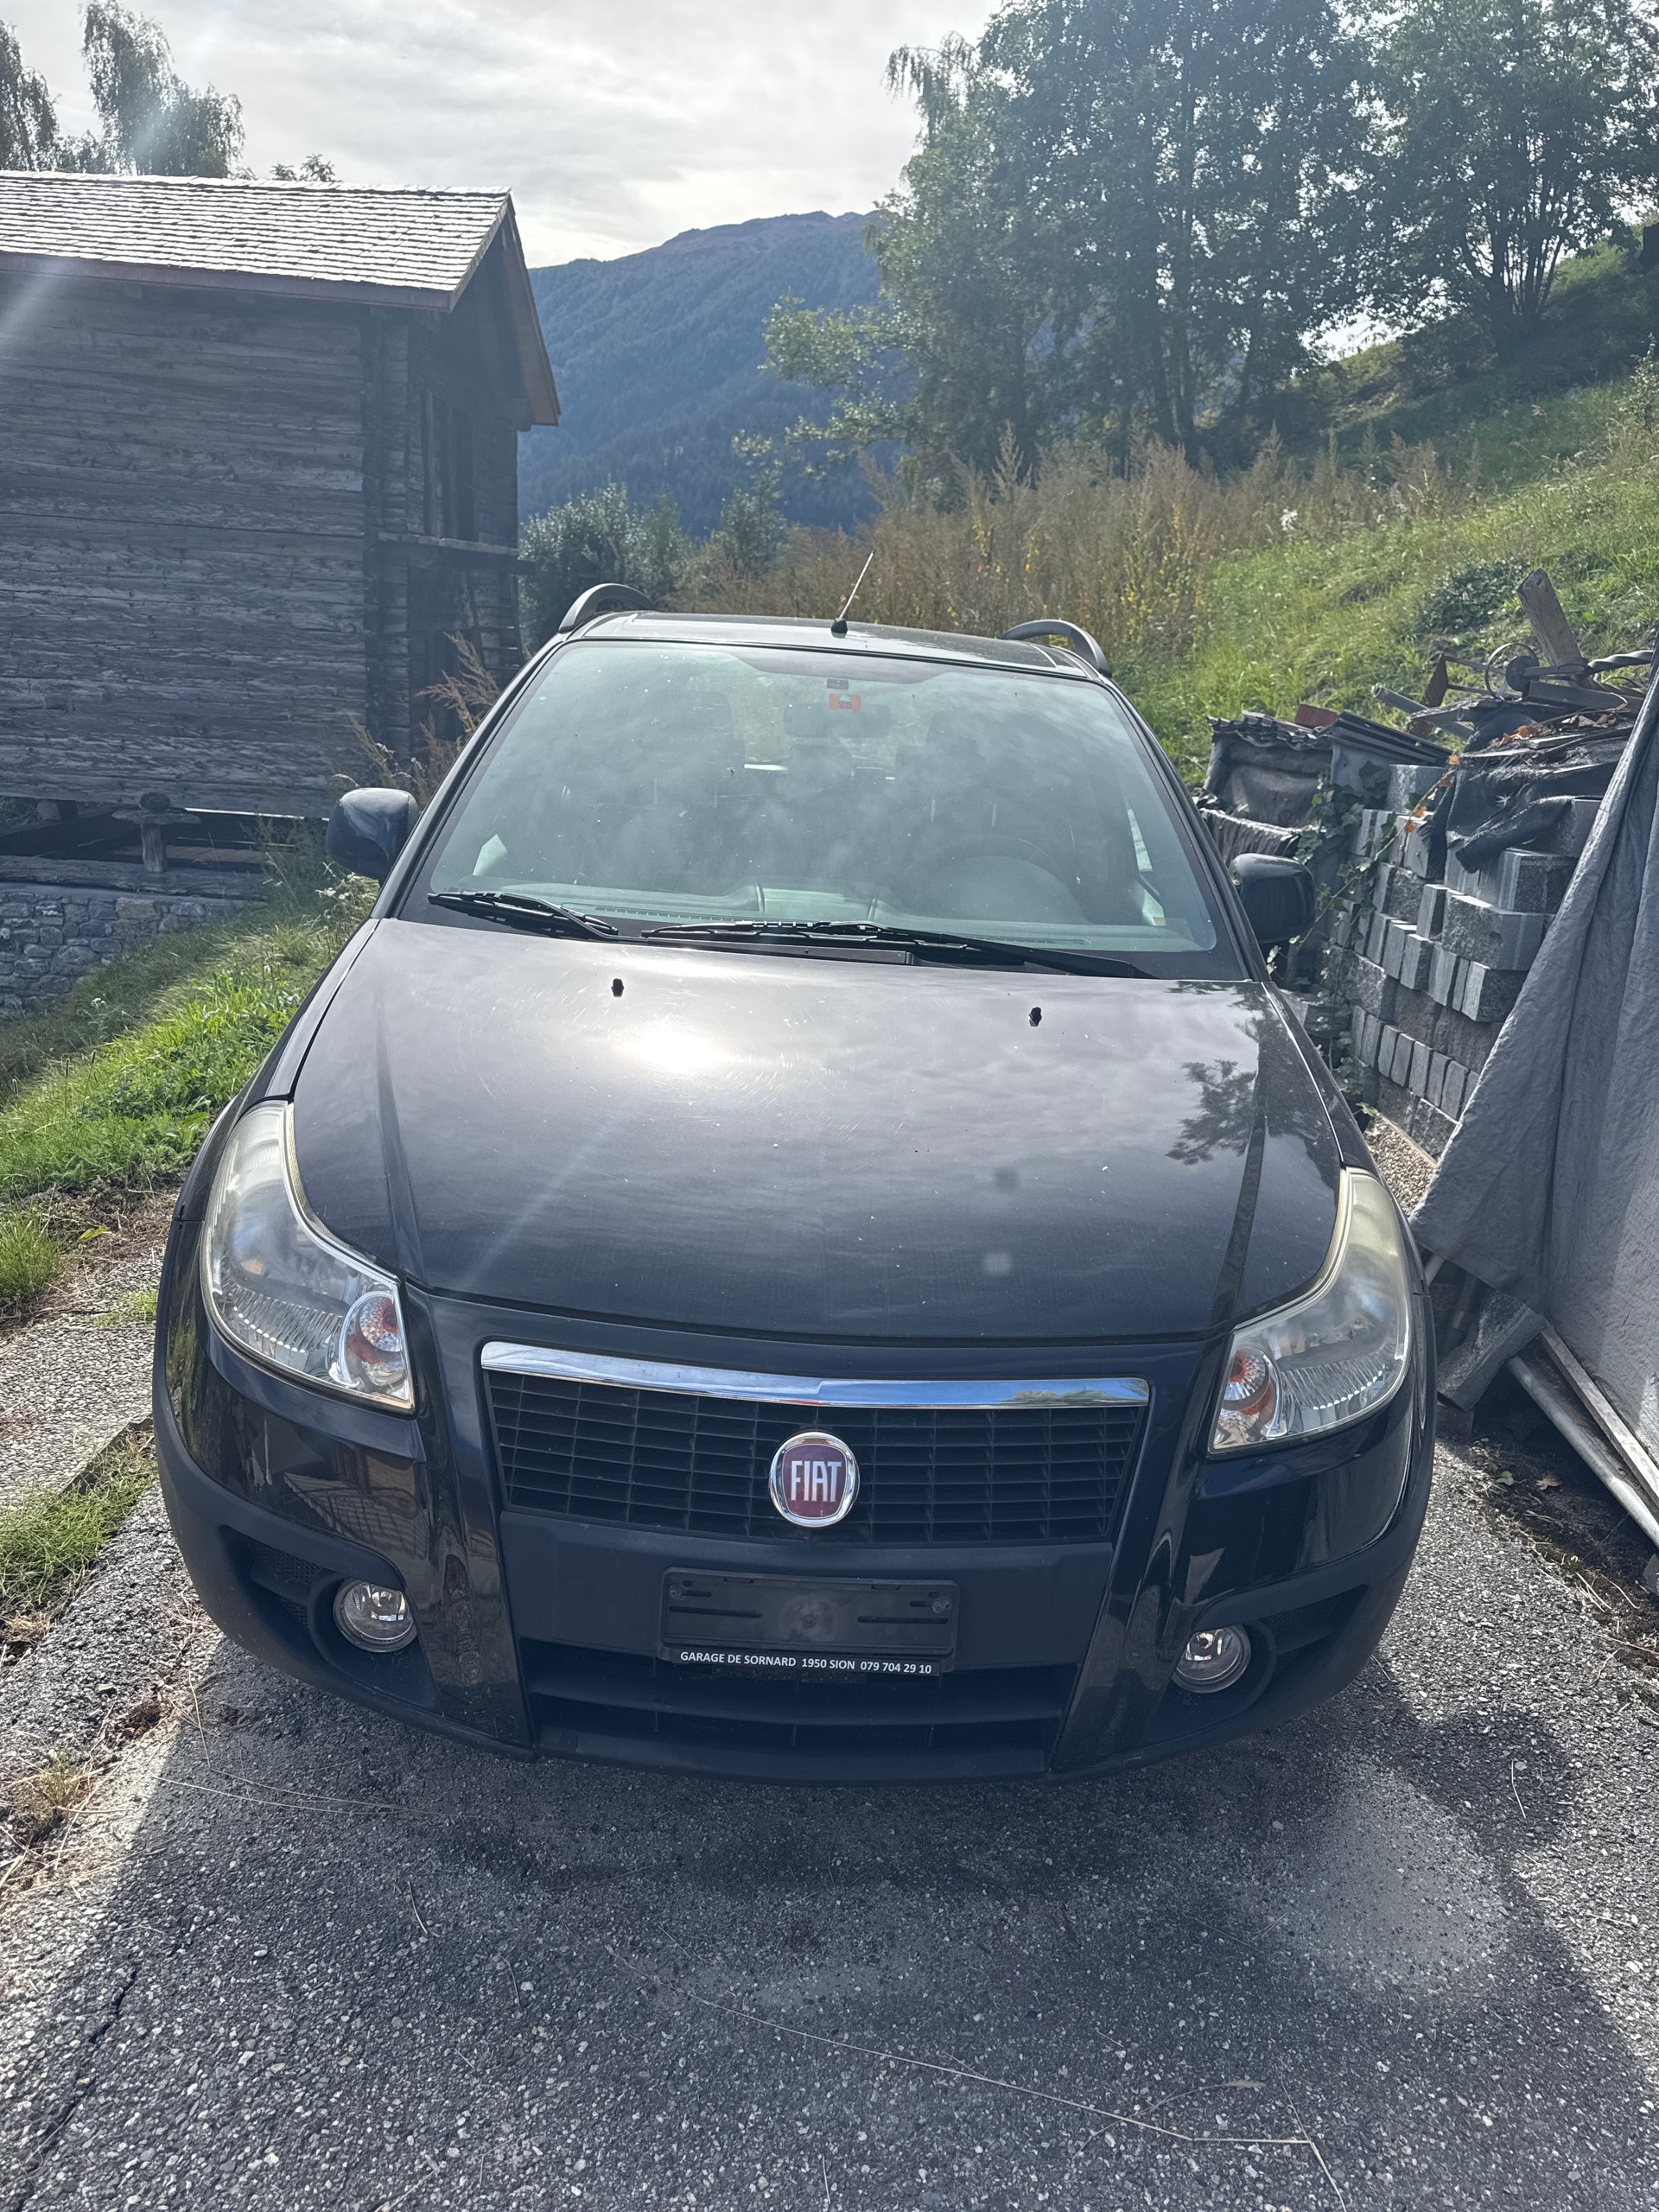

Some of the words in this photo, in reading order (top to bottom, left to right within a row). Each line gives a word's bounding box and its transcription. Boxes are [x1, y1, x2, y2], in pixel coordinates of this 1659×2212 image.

[791, 1460, 842, 1503] FIAT
[680, 1651, 725, 1663] GARAGE
[728, 1654, 742, 1664] DE
[743, 1655, 797, 1667] SORNARD
[801, 1658, 827, 1669] 1950
[829, 1659, 855, 1669] SION
[860, 1661, 880, 1671] 079
[882, 1662, 901, 1673] 704
[903, 1663, 917, 1674] 29
[918, 1664, 932, 1675] 10
